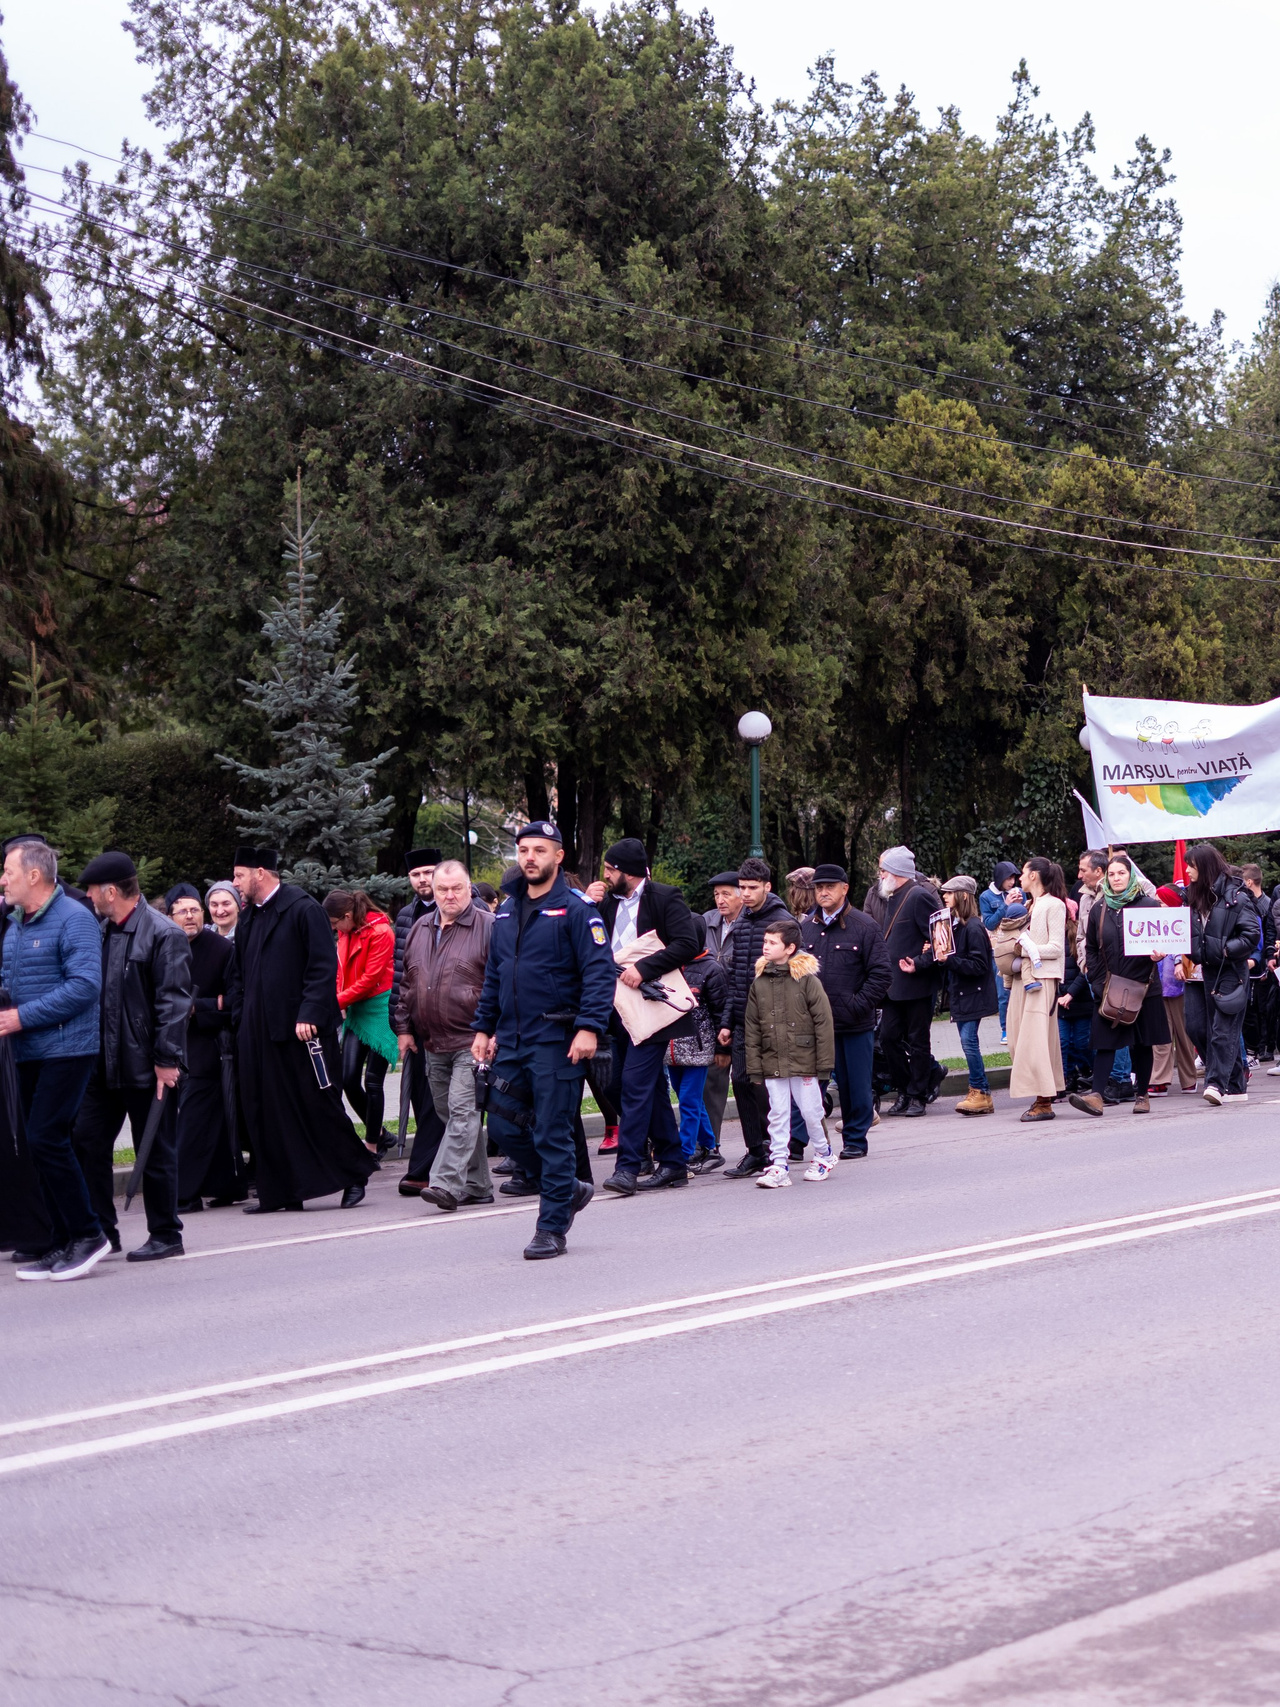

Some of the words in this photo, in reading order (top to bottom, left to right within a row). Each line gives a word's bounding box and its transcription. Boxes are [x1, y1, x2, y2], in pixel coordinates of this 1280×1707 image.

[1103, 764, 1175, 782] MARȘUL
[1177, 765, 1198, 779] pentru
[1197, 752, 1252, 776] VIAȚĂ
